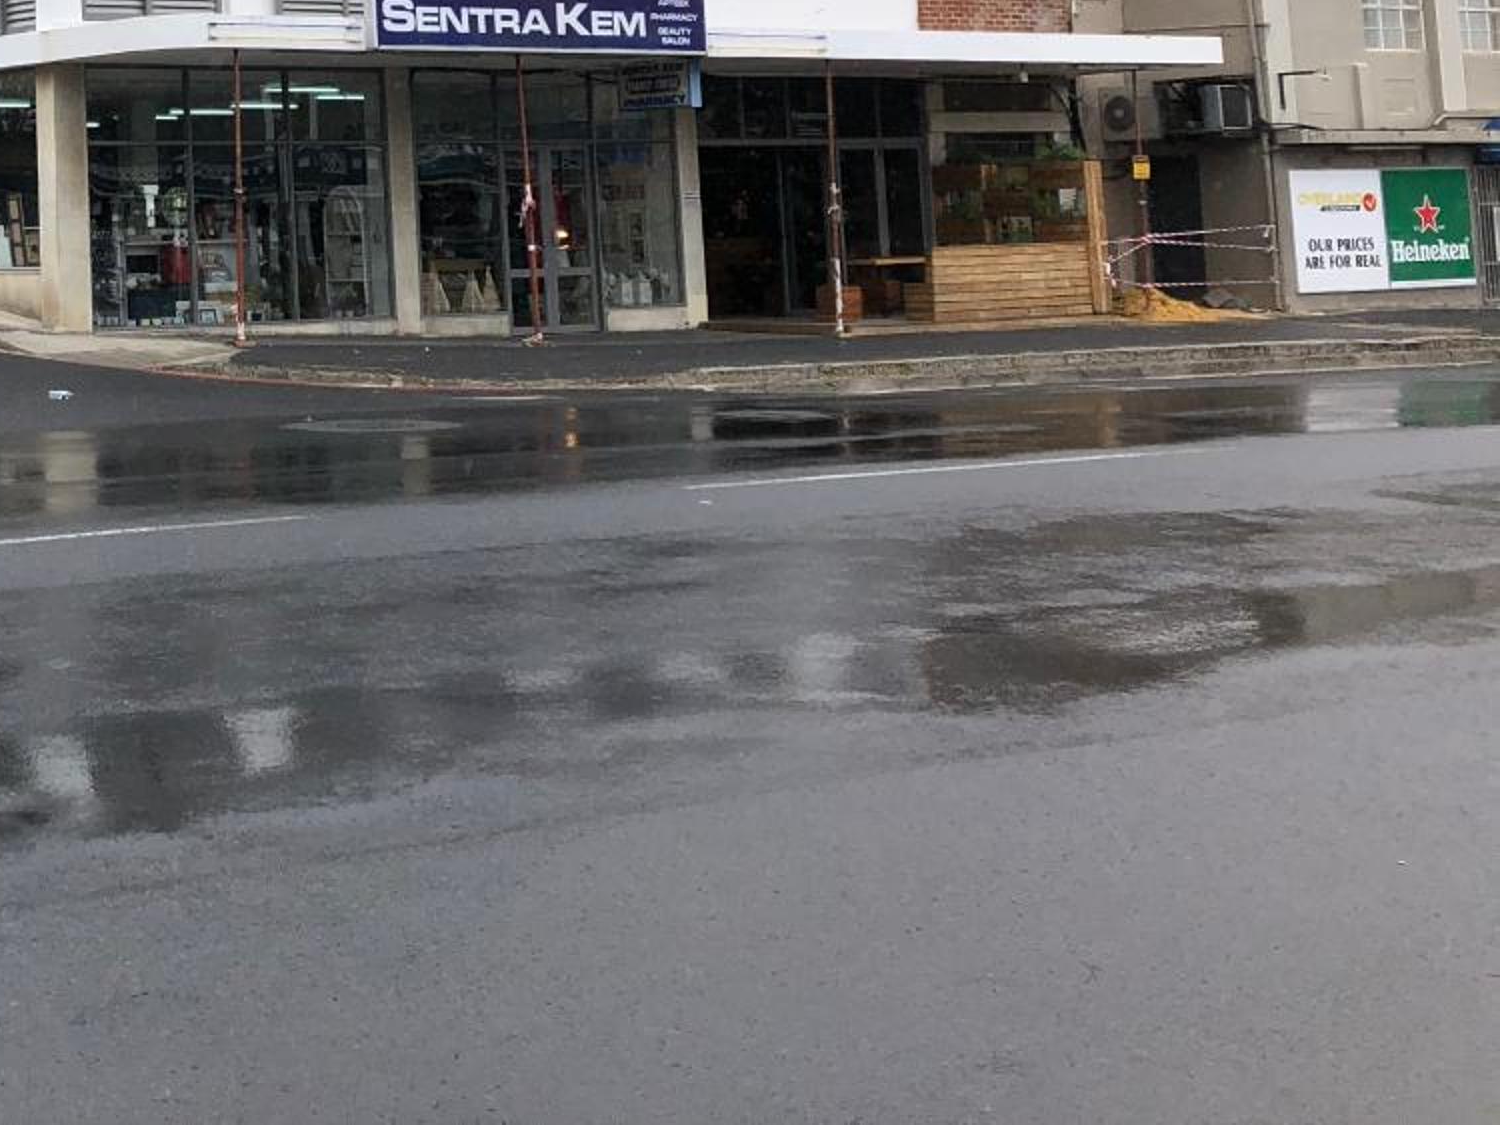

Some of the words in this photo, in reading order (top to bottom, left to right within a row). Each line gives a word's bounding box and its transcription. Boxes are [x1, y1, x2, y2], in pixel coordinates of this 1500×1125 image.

[650, 12, 698, 22] PHARMACY
[657, 26, 692, 36] BEAUTY
[661, 36, 691, 46] SALON
[1308, 238, 1333, 252] OUR
[1337, 236, 1375, 251] PRICES
[1391, 239, 1470, 263] Heineken
[1305, 256, 1326, 270] ARE
[1330, 255, 1352, 269] FOR
[1355, 254, 1381, 267] REAL
